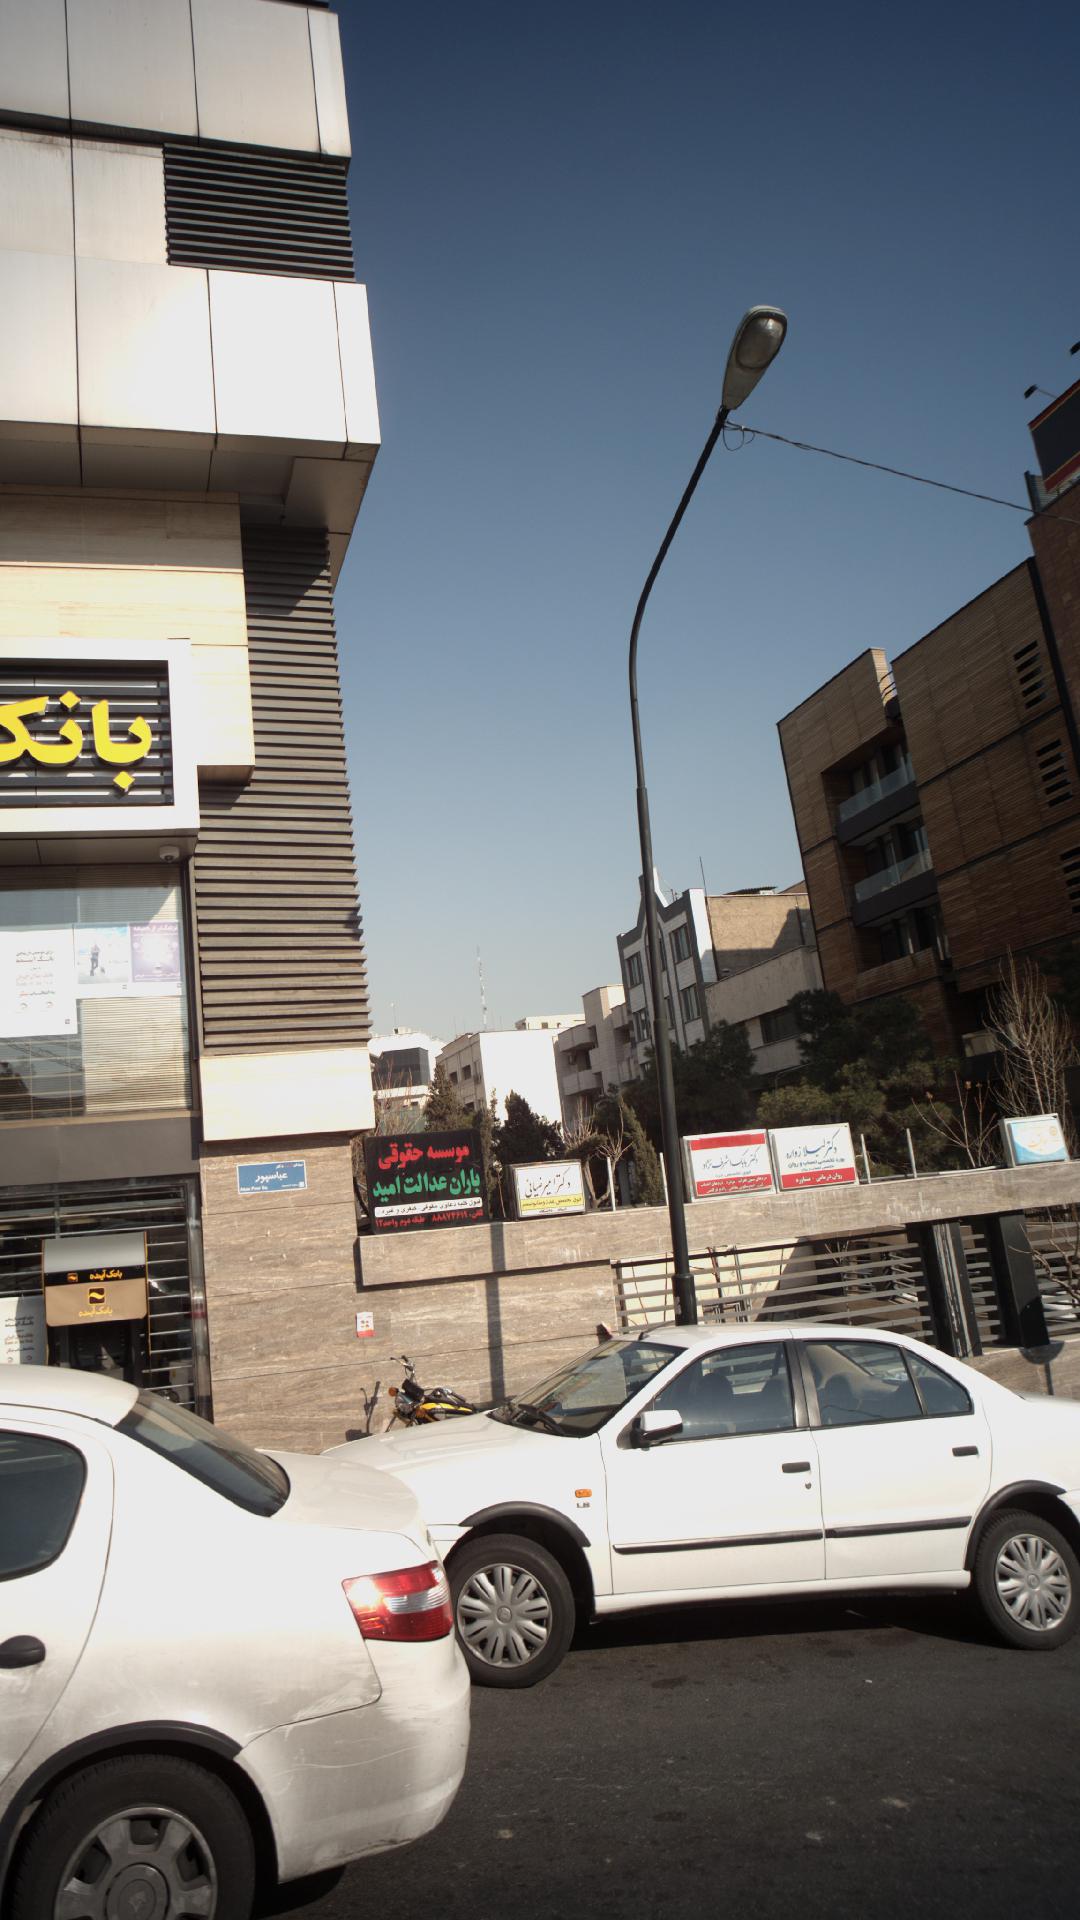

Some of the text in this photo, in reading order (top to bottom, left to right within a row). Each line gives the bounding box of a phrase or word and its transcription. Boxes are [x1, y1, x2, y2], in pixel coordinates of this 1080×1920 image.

[378, 1142, 423, 1170] حقوقی
[255, 1171, 288, 1184] عباسپور
[372, 1168, 480, 1203] باران عدالت امید
